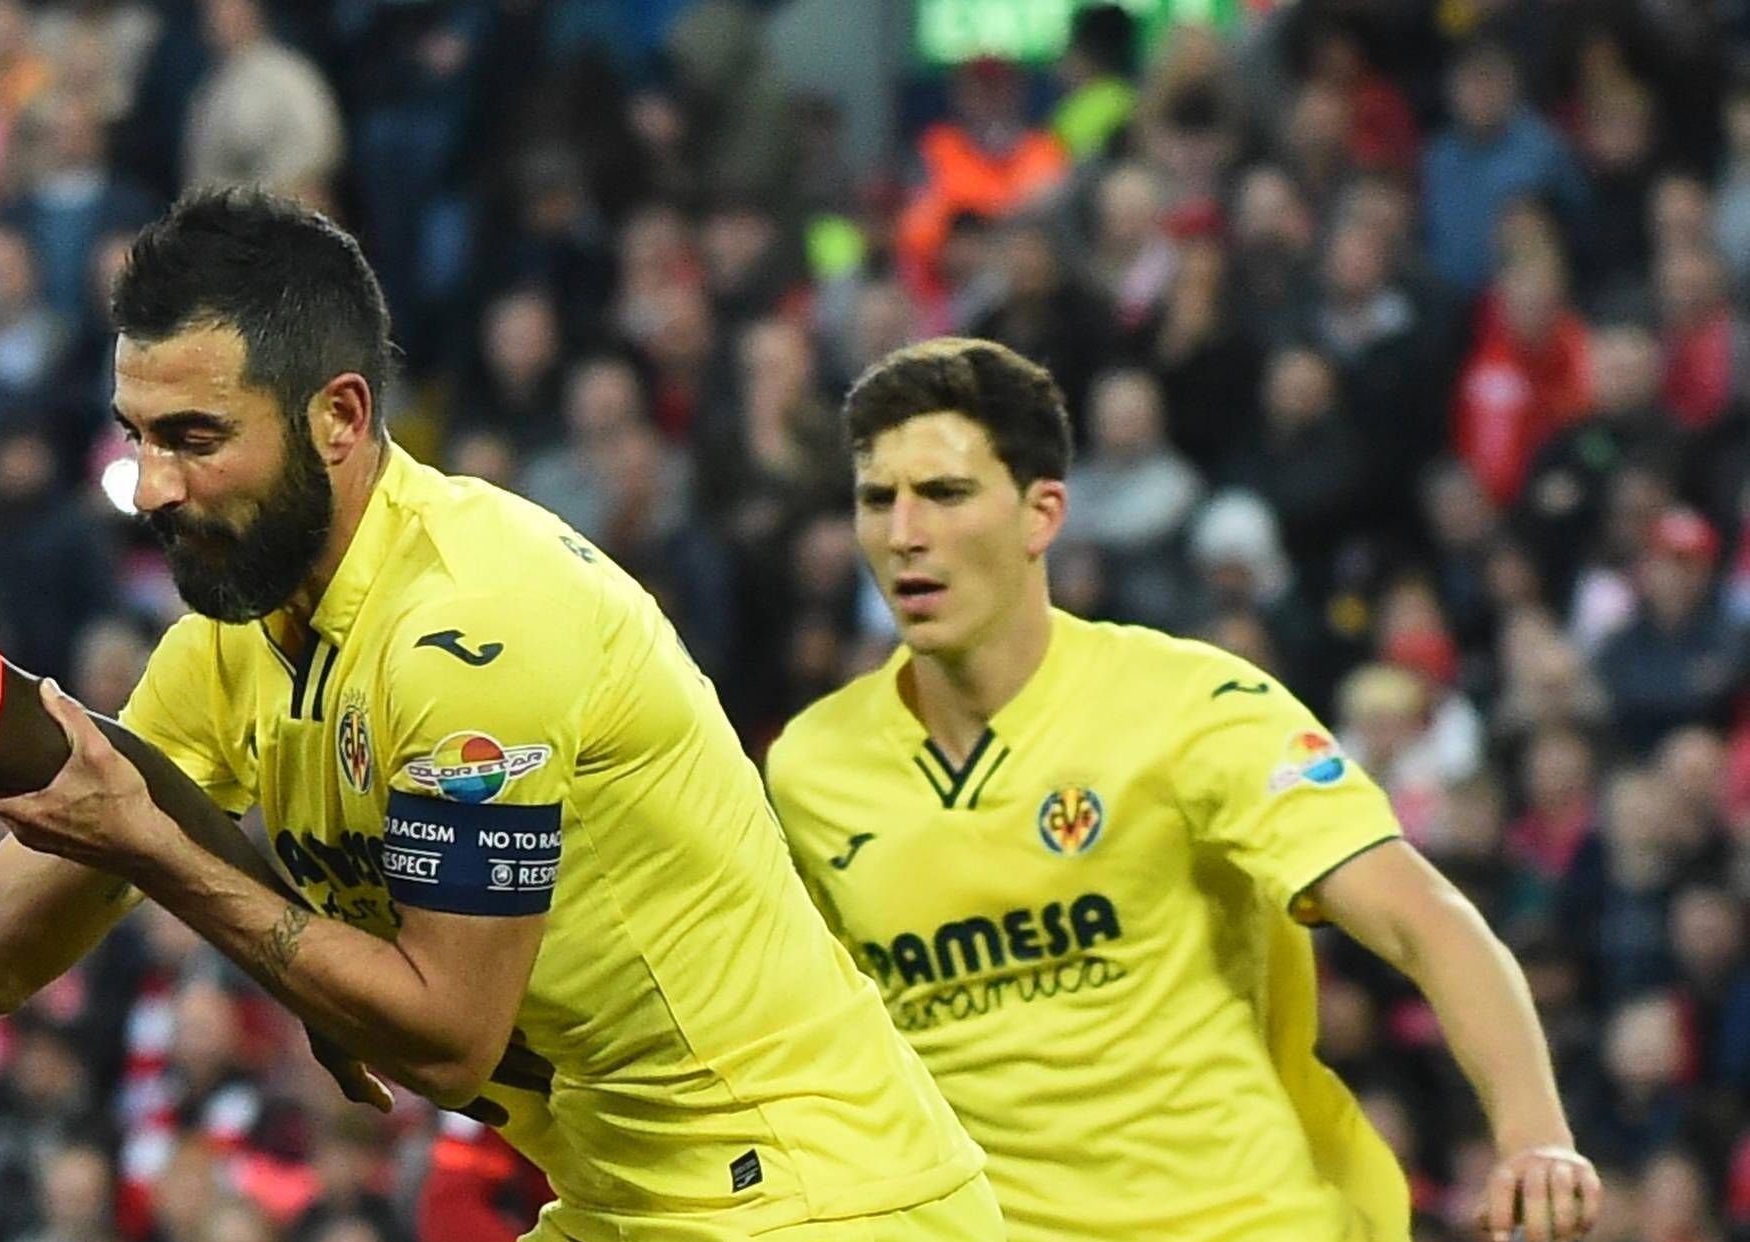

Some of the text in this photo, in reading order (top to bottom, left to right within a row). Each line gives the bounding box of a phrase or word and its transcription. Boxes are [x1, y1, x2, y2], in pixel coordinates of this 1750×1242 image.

[390, 818, 455, 844] RACISM
[478, 830, 562, 850] NO TO RAC
[382, 851, 441, 877] ESPECT
